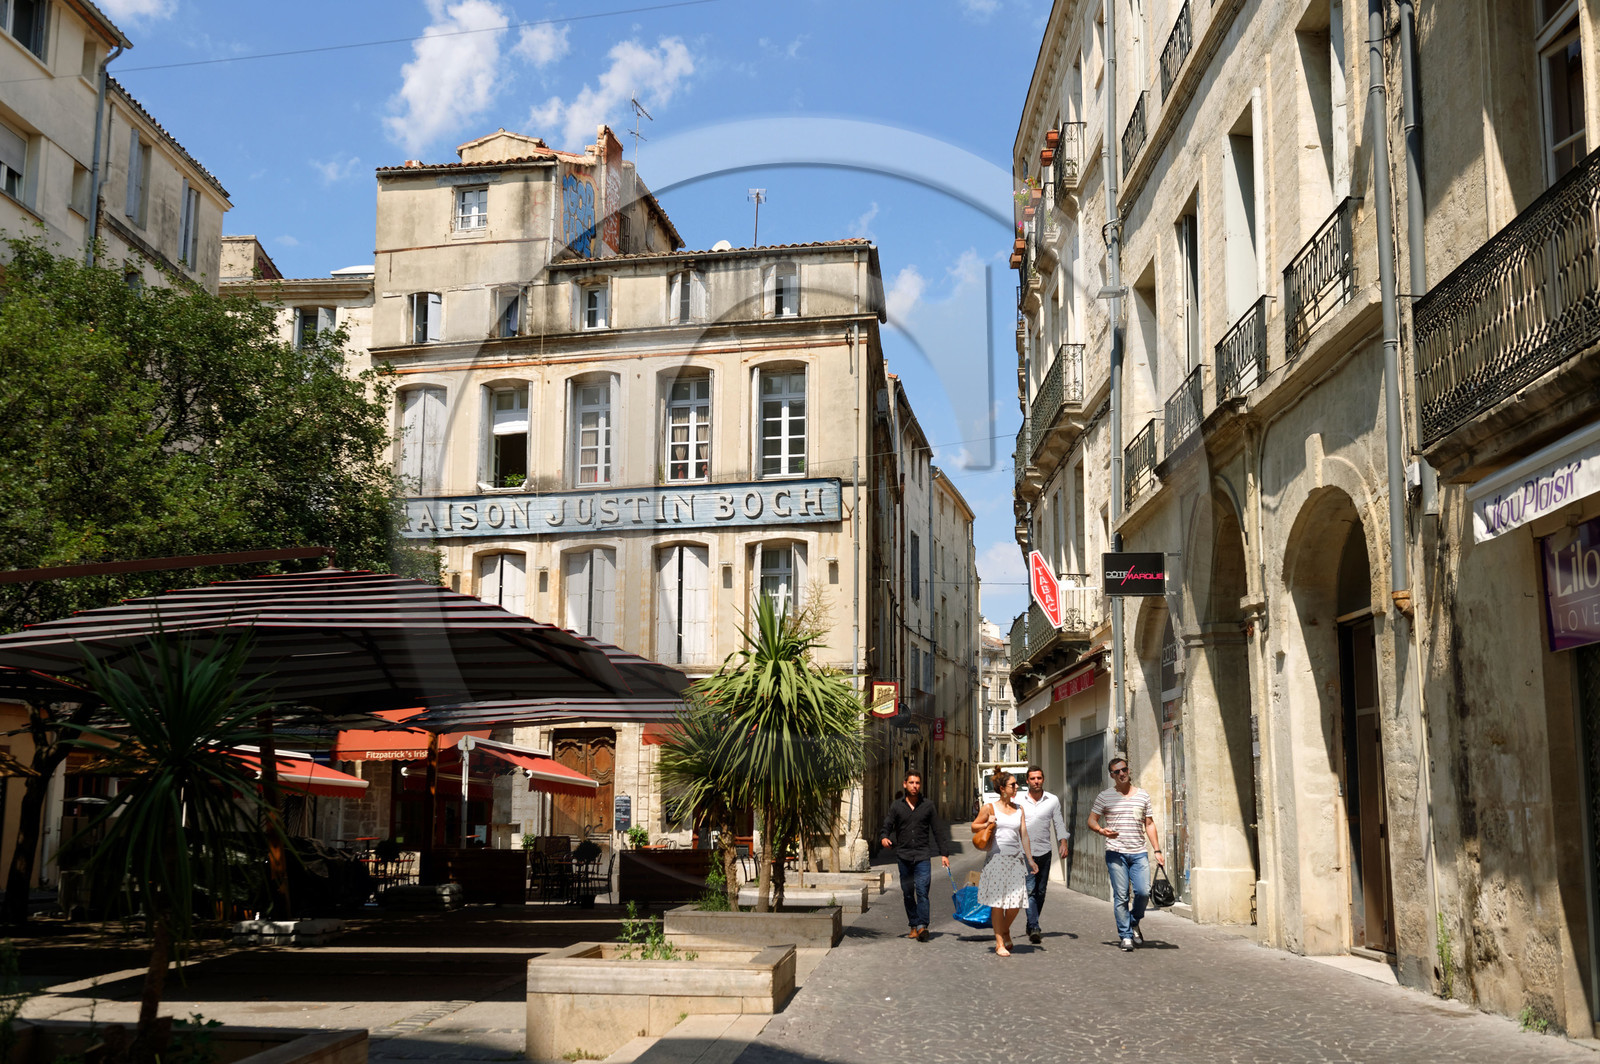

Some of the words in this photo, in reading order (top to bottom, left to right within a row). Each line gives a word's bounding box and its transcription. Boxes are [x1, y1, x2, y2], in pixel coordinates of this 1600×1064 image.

[545, 494, 697, 527] JUSTIN
[714, 487, 826, 521] BOCH
[1035, 566, 1057, 612] TABAC
[1127, 572, 1164, 580] MARQUE
[1559, 603, 1600, 633] LOVE
